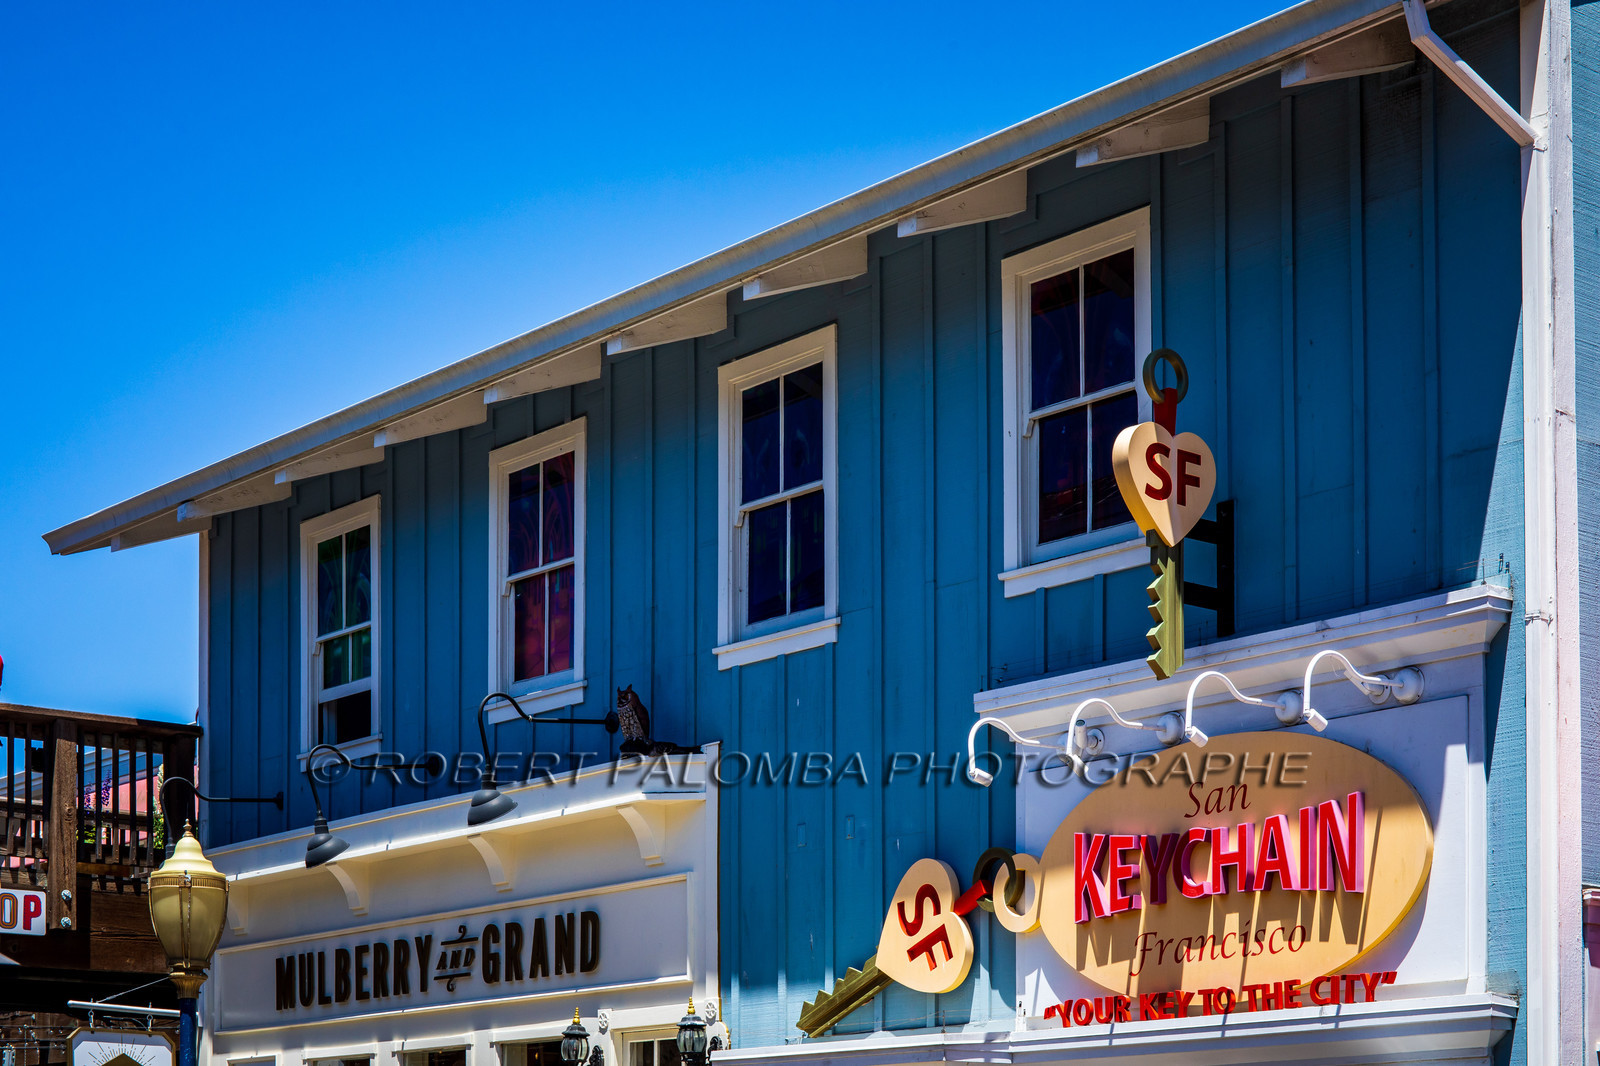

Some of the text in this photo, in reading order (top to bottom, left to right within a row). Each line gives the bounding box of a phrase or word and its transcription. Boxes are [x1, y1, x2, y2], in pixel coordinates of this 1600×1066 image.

[1144, 442, 1202, 507] SF
[1184, 782, 1251, 819] San
[1073, 790, 1365, 924] KEYCHAIN
[896, 883, 954, 972] SF
[1129, 924, 1306, 976] Francisco
[275, 910, 601, 1011] MULBERRY AND GRAND
[1139, 989, 1196, 1021] KEY
[1197, 986, 1237, 1016] TO
[1242, 979, 1303, 1011] THE
